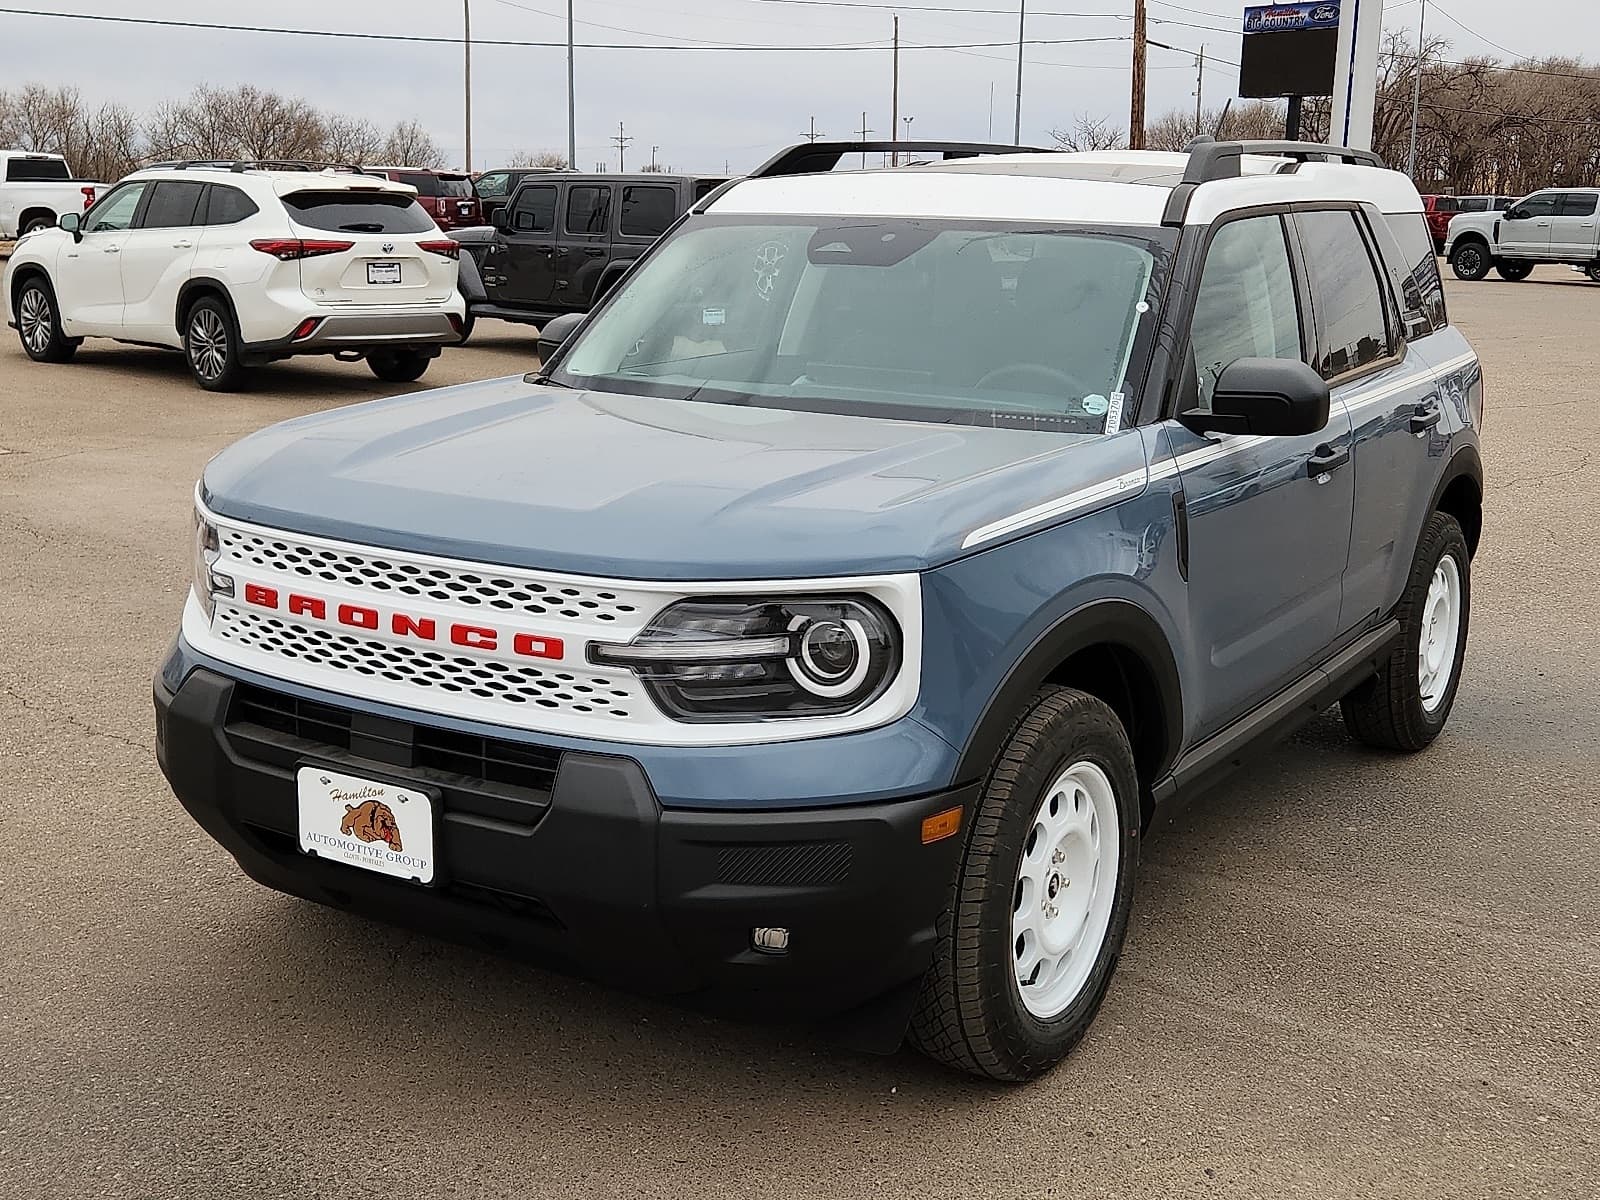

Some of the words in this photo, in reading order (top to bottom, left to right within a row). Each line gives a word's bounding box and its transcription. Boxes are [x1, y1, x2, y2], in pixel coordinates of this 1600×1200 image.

[1314, 5, 1335, 19] Ford
[1247, 19, 1261, 30] BIG
[1264, 16, 1307, 28] COUNTRY
[245, 583, 564, 660] BRONCO
[330, 786, 385, 802] Hamilton
[306, 832, 383, 859] AUTOMOTIVE
[386, 852, 427, 869] GROUP
